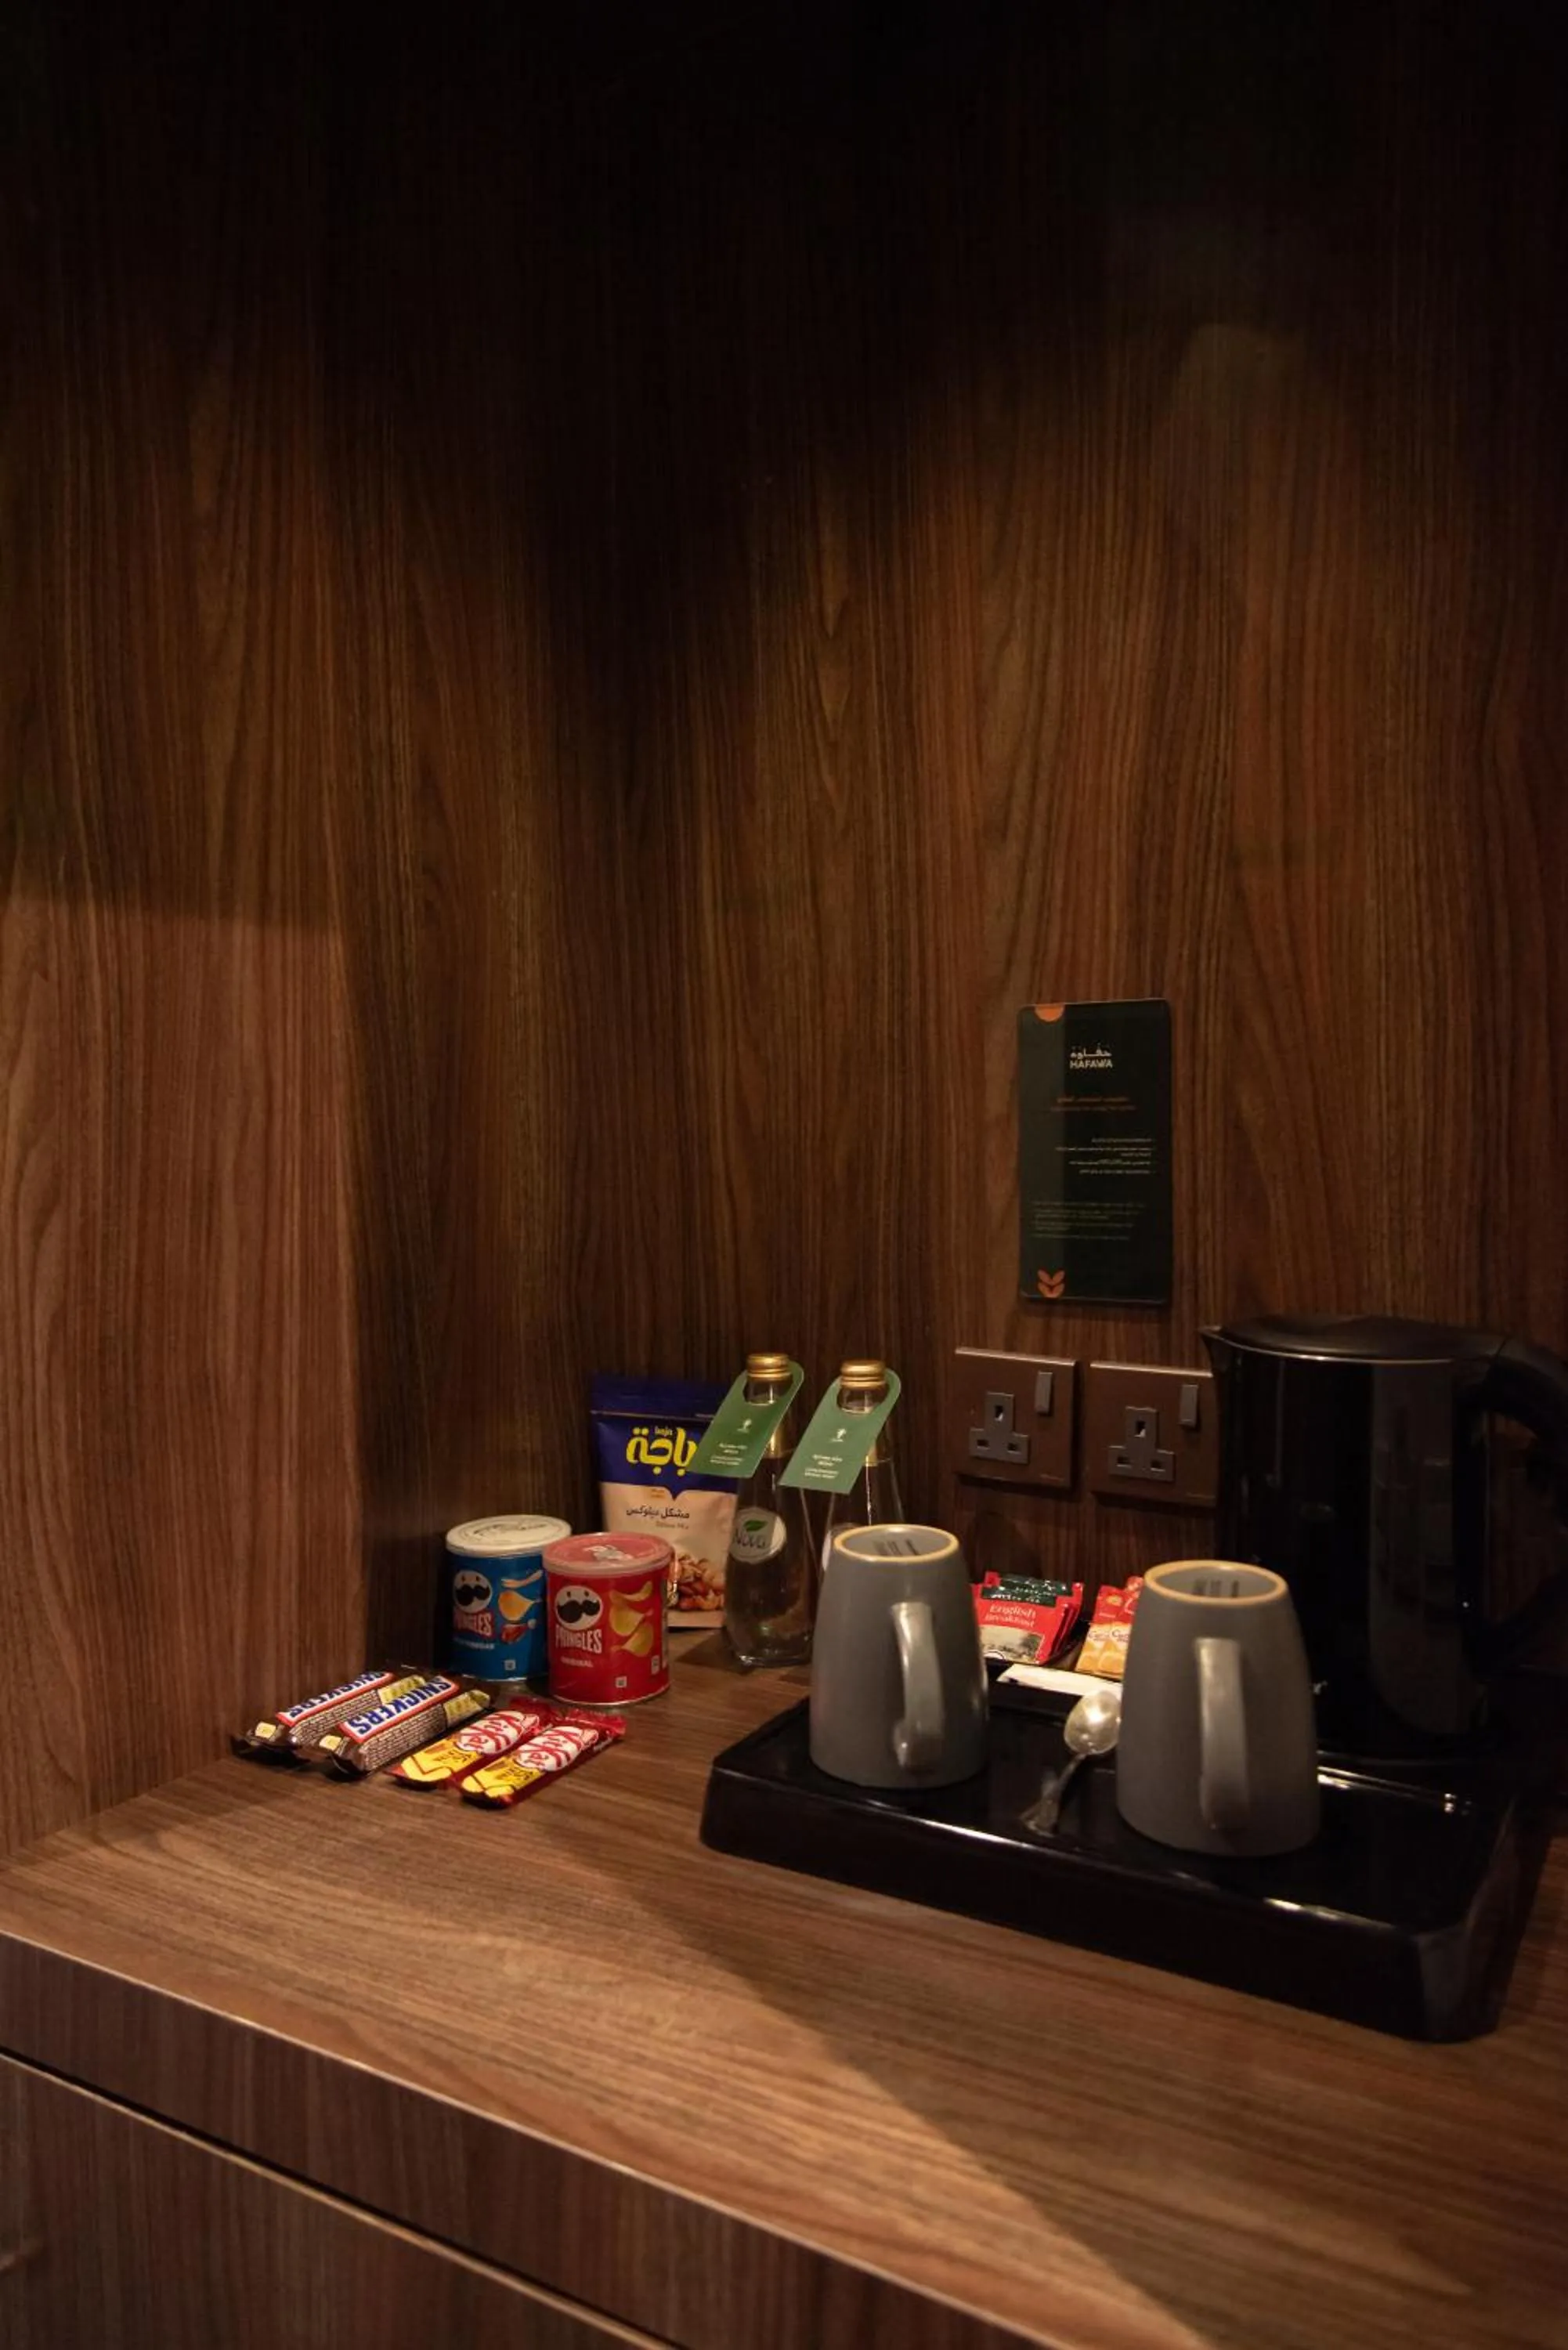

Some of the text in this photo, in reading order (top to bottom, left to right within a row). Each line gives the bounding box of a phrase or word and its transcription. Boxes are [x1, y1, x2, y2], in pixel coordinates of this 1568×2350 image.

[1069, 1058, 1113, 1069] HAFAWA
[555, 1624, 602, 1654] PRINGLES
[349, 1678, 452, 1734] SNICKERS
